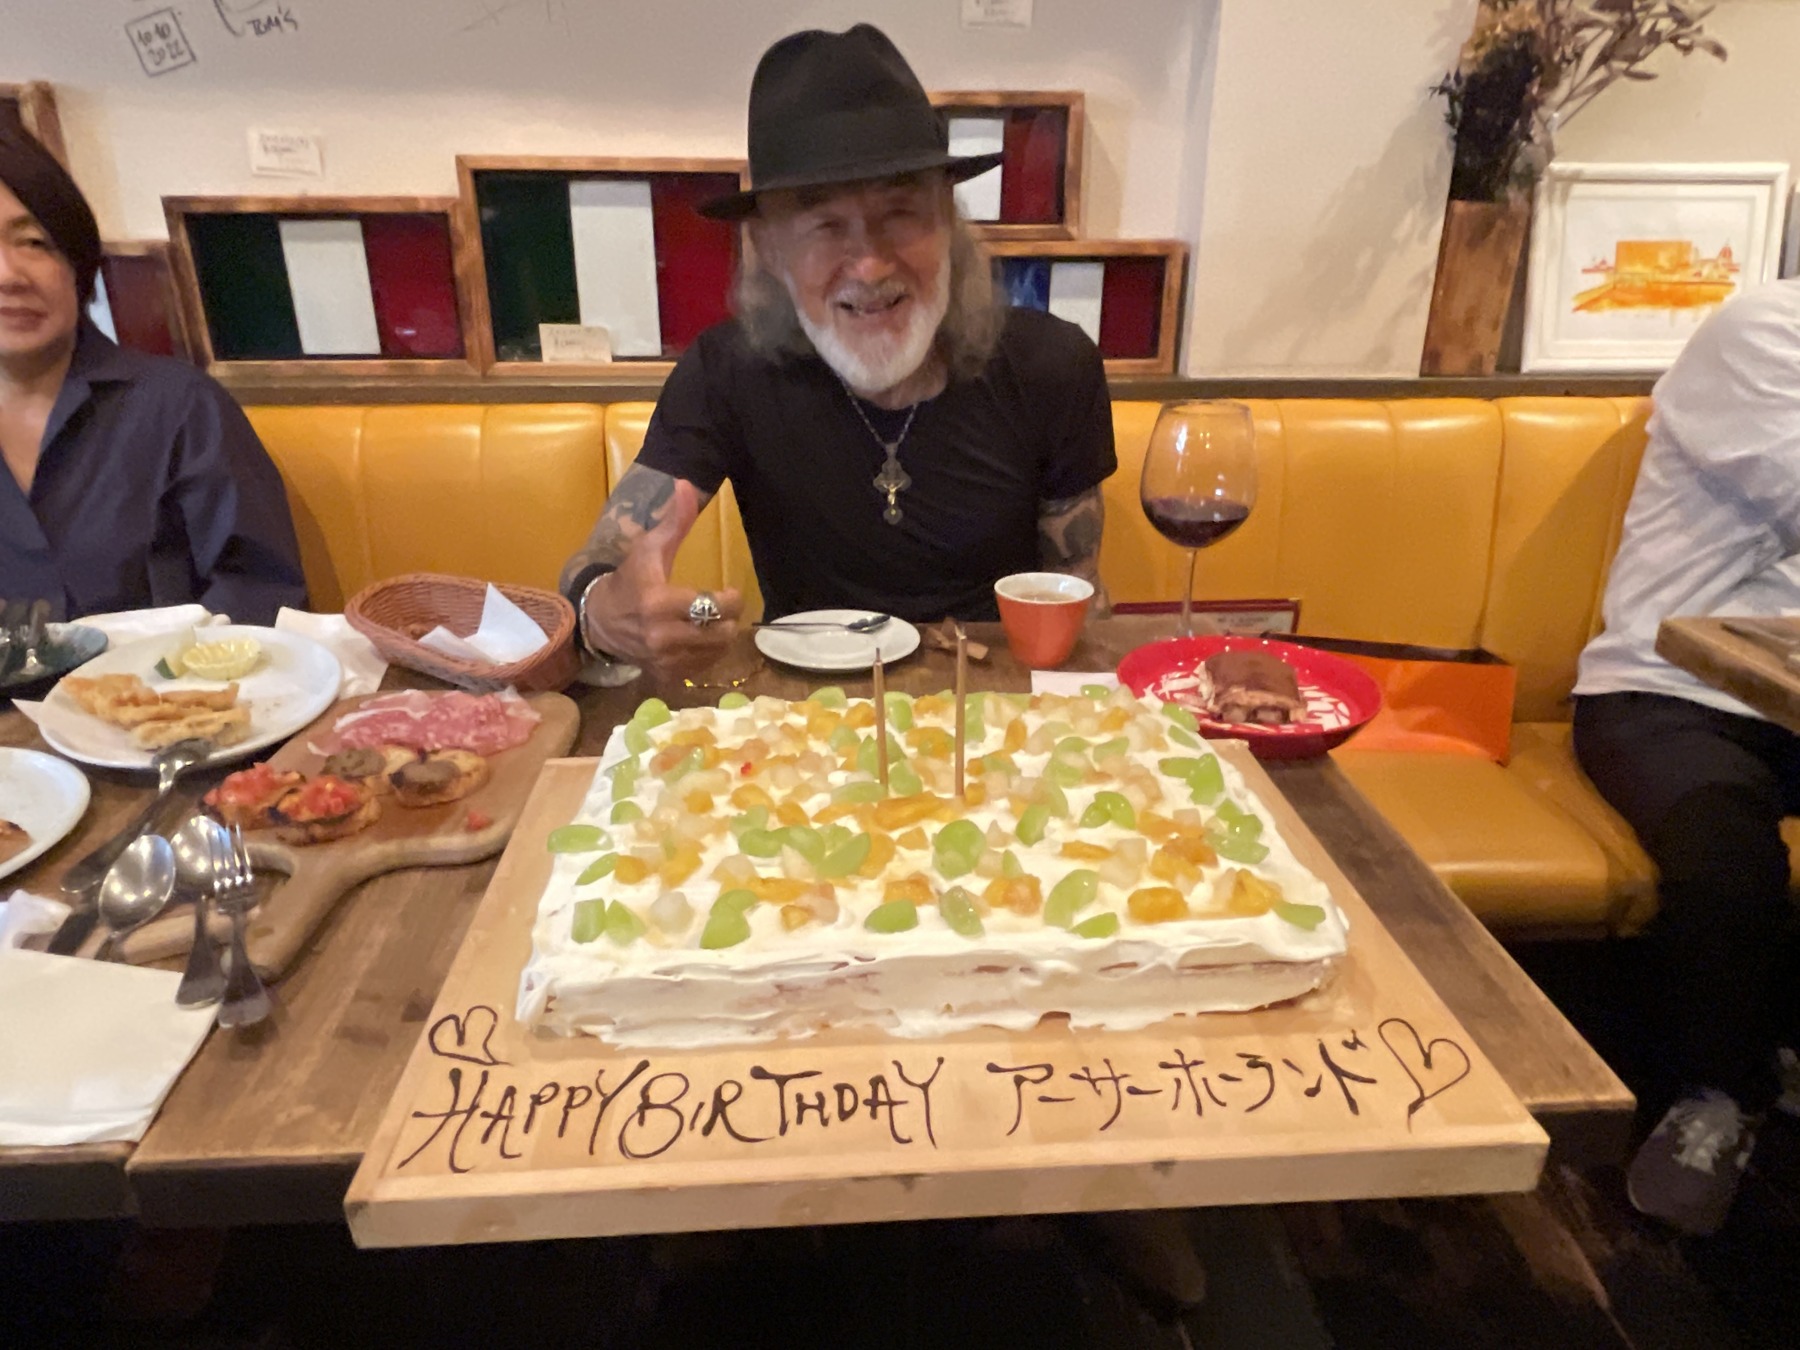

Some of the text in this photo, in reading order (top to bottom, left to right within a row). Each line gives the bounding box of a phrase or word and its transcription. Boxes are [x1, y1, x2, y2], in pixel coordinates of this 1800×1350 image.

[398, 1056, 945, 1173] HAPPY BIRTHDAY
[986, 1029, 1378, 1136] アーサーホーランド
